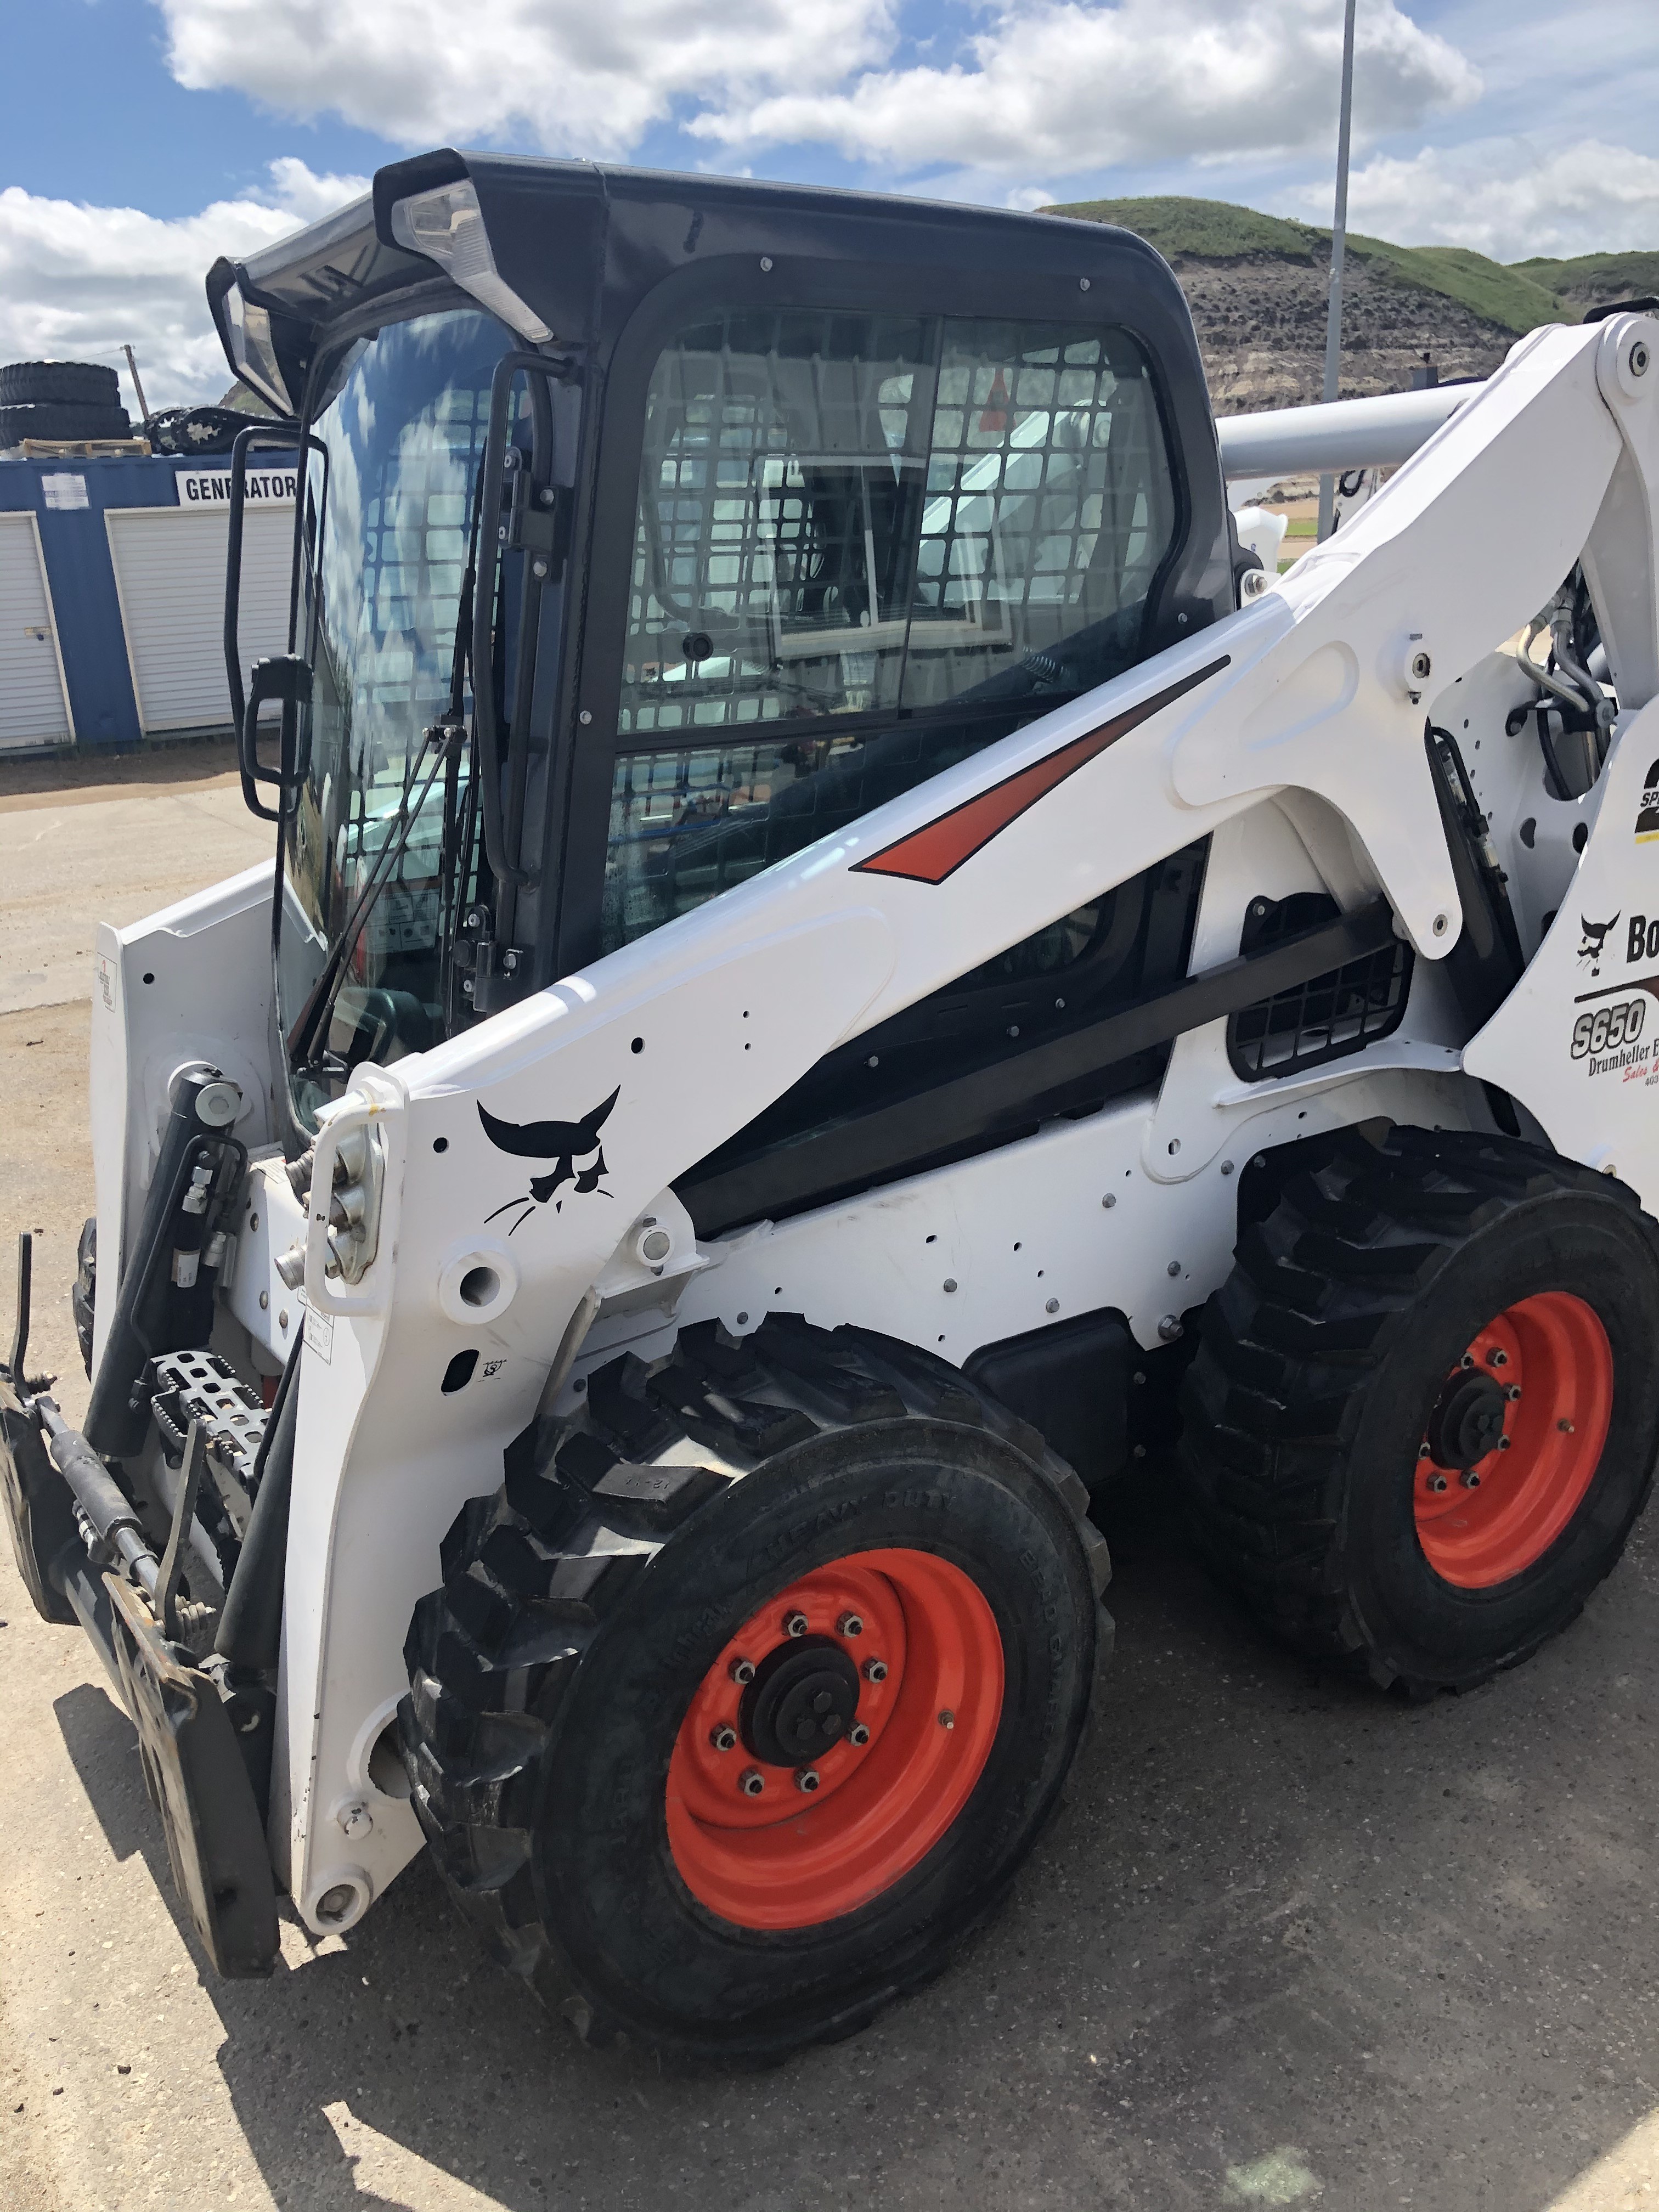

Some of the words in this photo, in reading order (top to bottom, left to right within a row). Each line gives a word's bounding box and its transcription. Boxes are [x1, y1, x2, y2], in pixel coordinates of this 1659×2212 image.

[1640, 792, 1659, 807] SP
[1571, 998, 1646, 1059] S650
[1589, 1044, 1650, 1076] Drumheller
[1622, 1065, 1647, 1082] Sales
